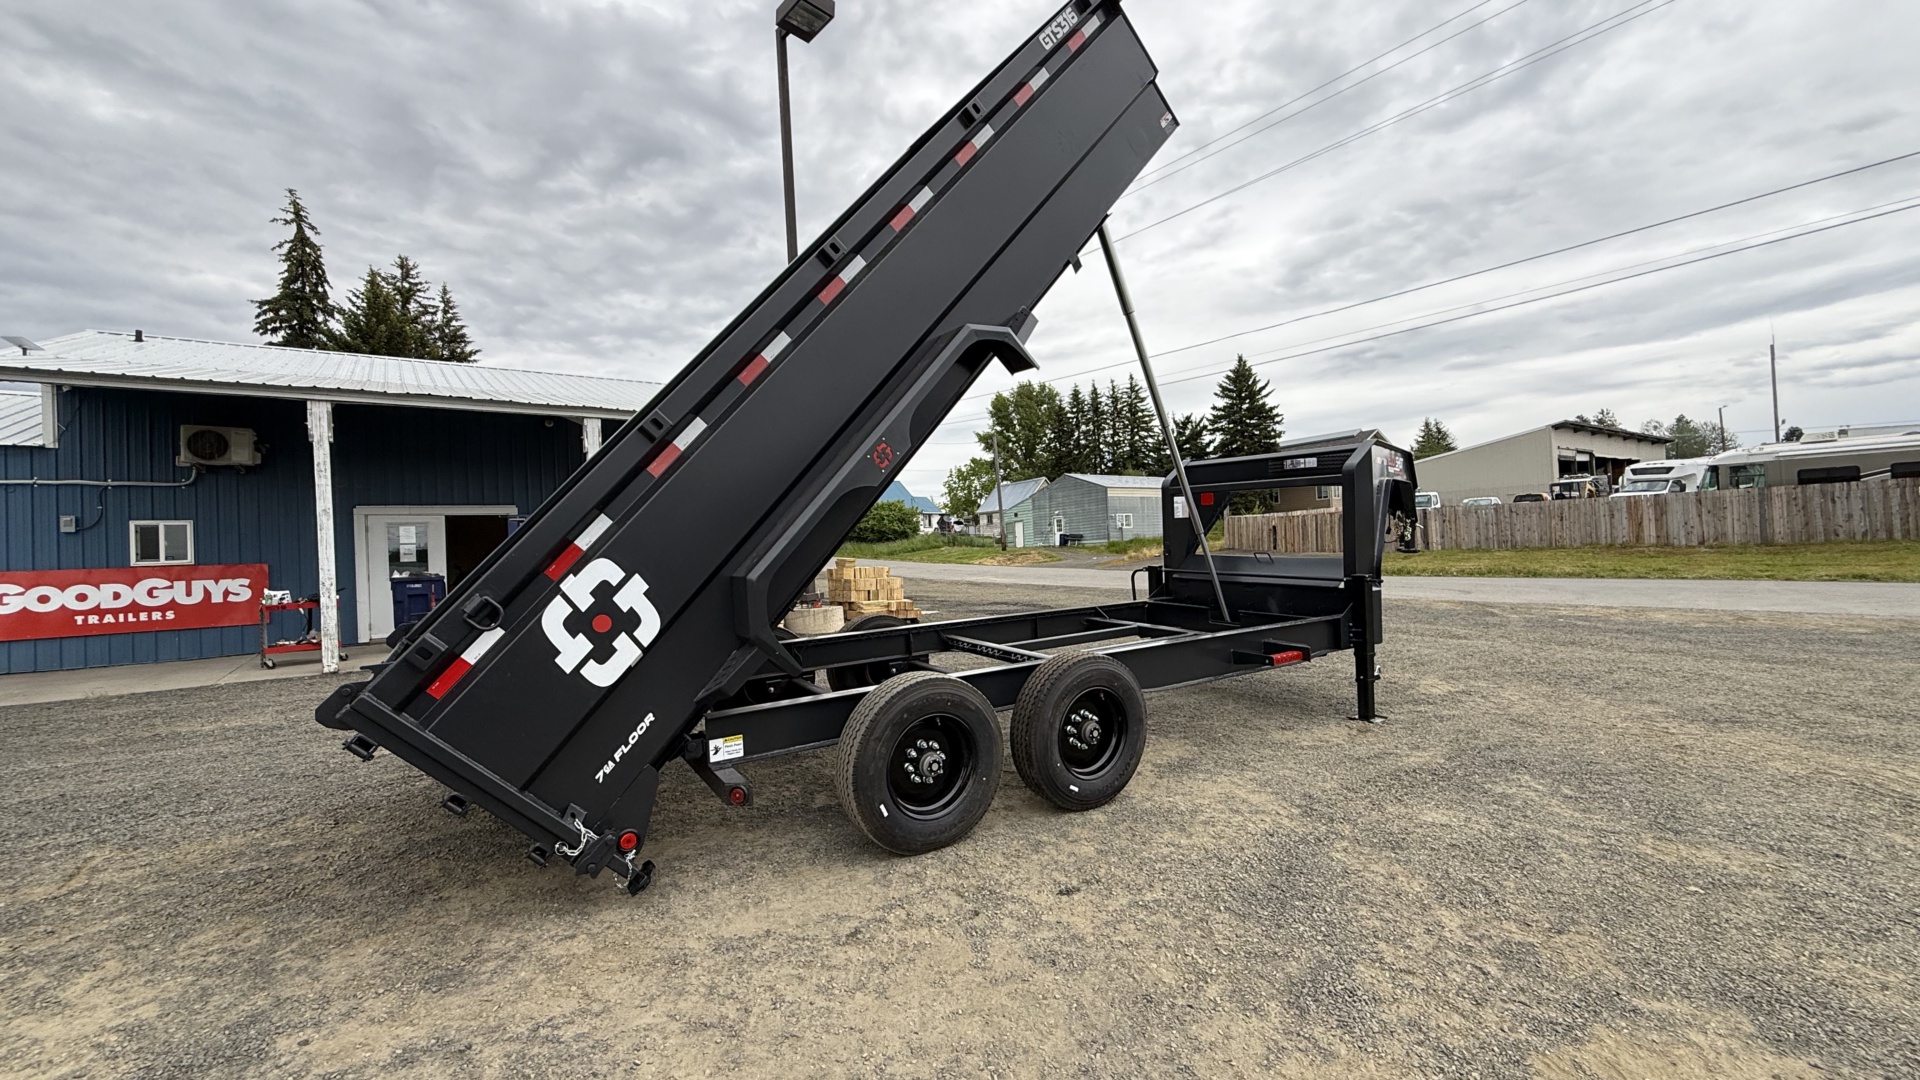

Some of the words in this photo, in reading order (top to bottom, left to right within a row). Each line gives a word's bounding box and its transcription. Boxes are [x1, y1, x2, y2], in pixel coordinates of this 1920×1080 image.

[1039, 7, 1078, 49] GTS316
[74, 610, 176, 625] TRAILERS
[613, 712, 656, 762] FLOOR
